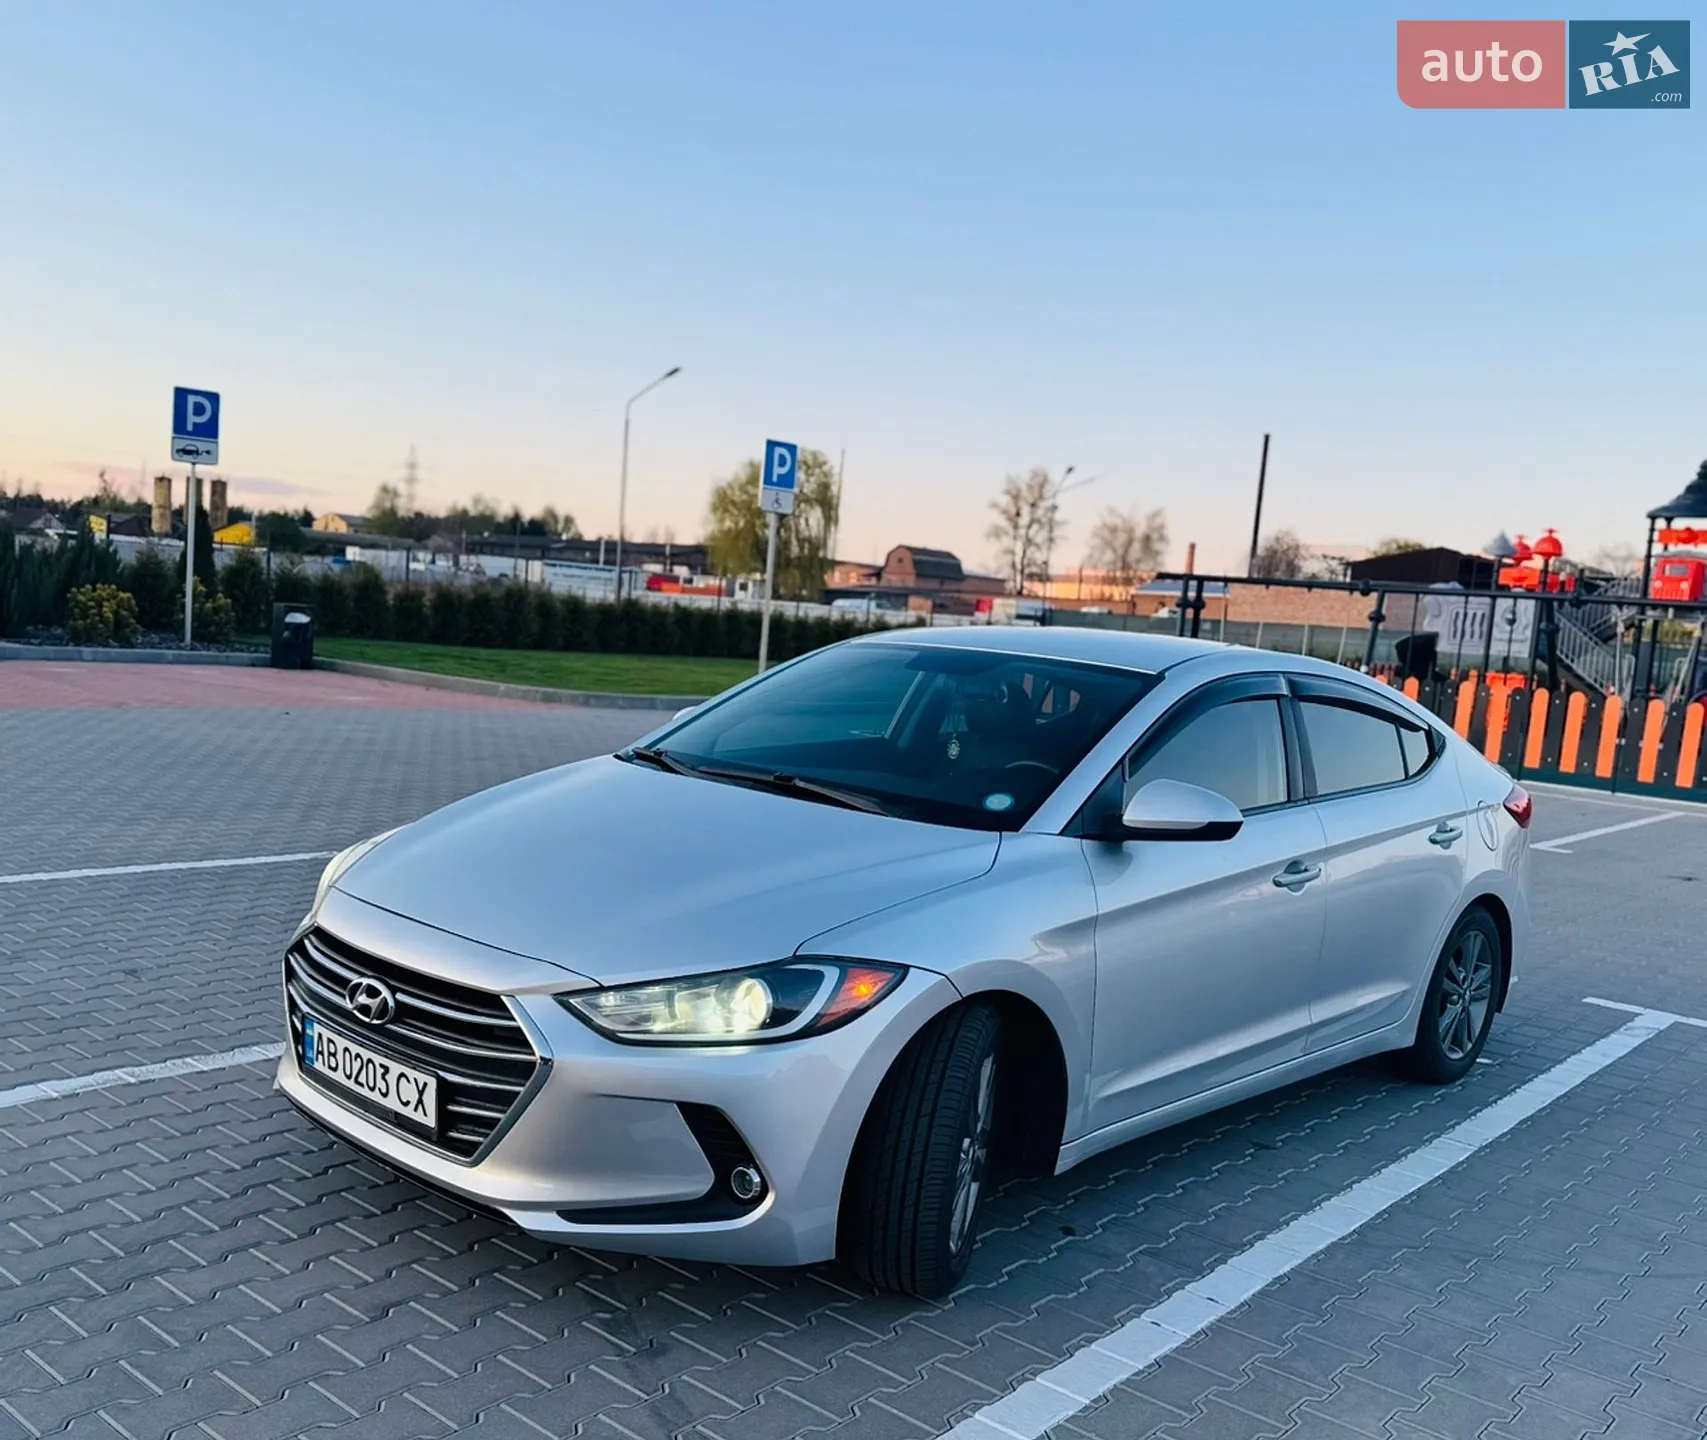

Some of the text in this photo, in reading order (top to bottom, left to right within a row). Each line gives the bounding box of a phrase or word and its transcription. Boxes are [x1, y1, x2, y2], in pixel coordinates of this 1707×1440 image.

[186, 394, 212, 432] P
[772, 446, 792, 482] P
[316, 1032, 428, 1117] AB 0203 CX
